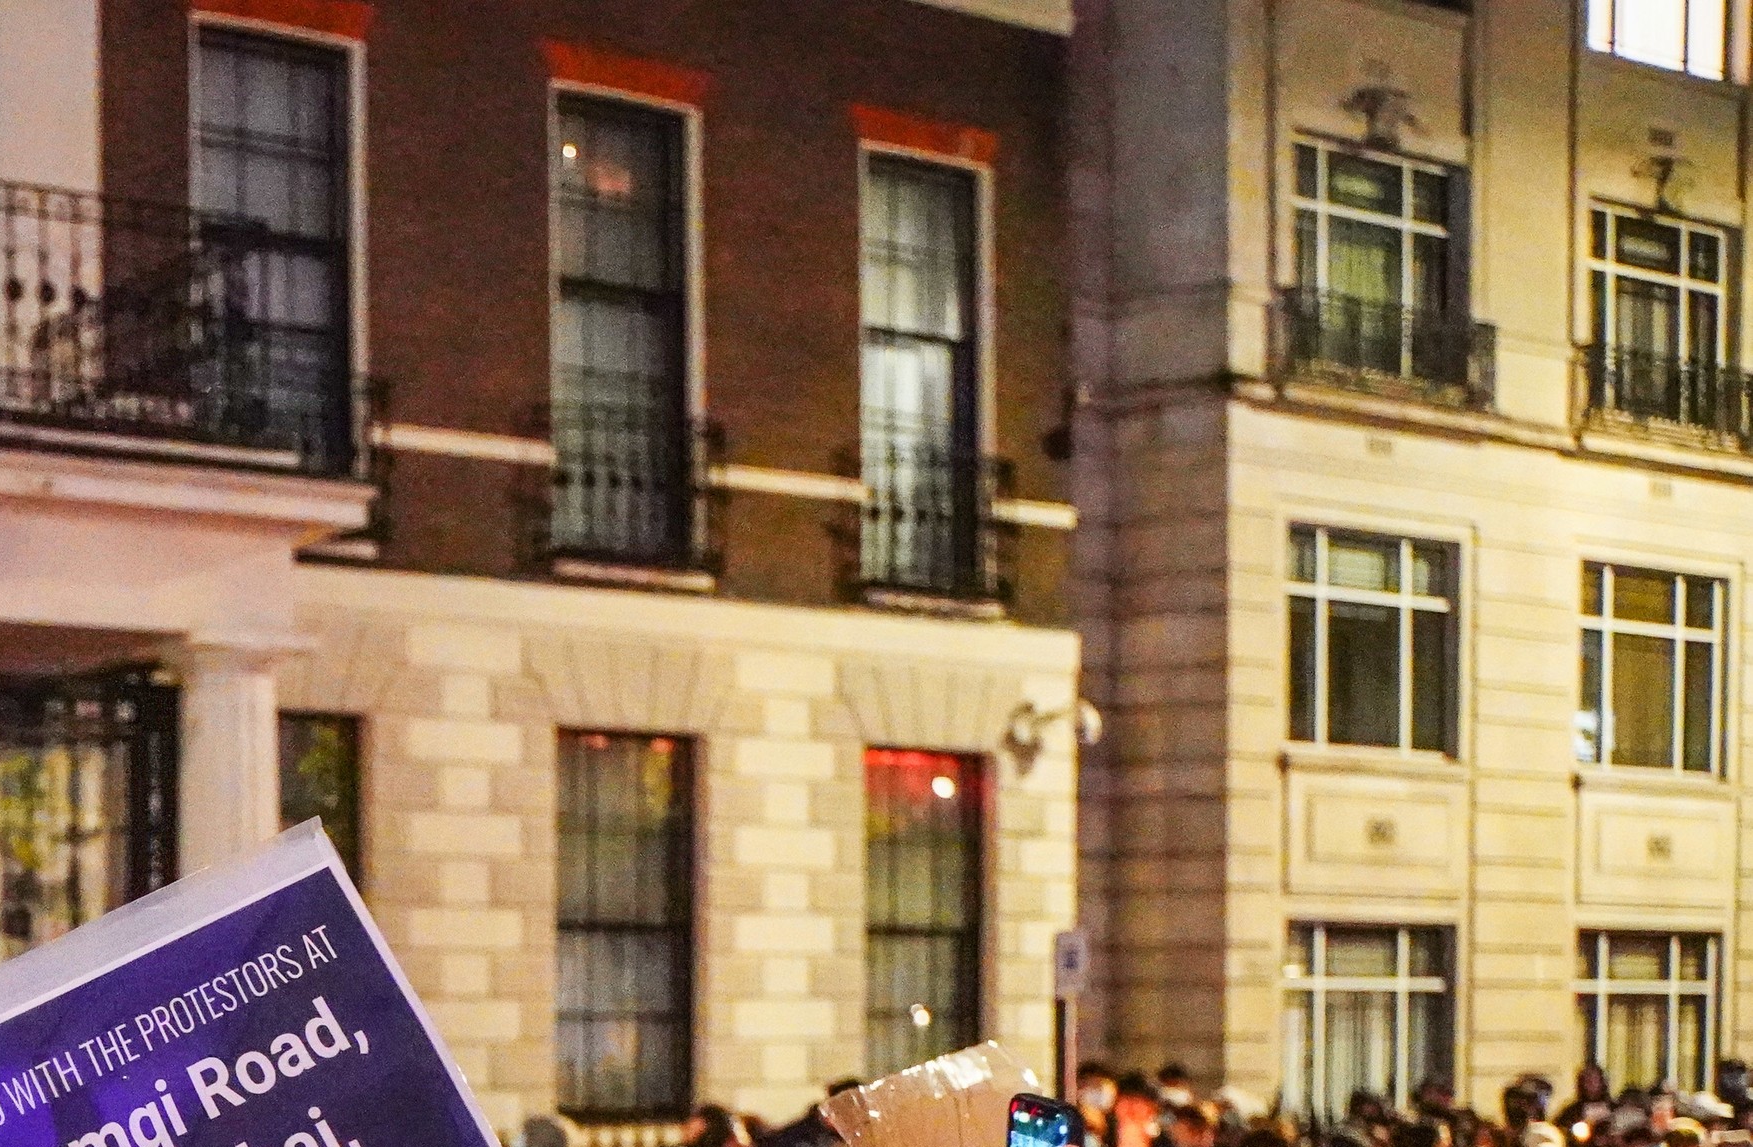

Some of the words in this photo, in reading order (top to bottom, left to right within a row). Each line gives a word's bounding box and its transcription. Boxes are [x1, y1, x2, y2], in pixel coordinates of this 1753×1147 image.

[1, 1051, 84, 1115] WITH
[78, 1023, 140, 1076] THE
[135, 945, 304, 1052] PROTESTORS
[302, 925, 338, 968] AT
[185, 997, 369, 1120] Road,
